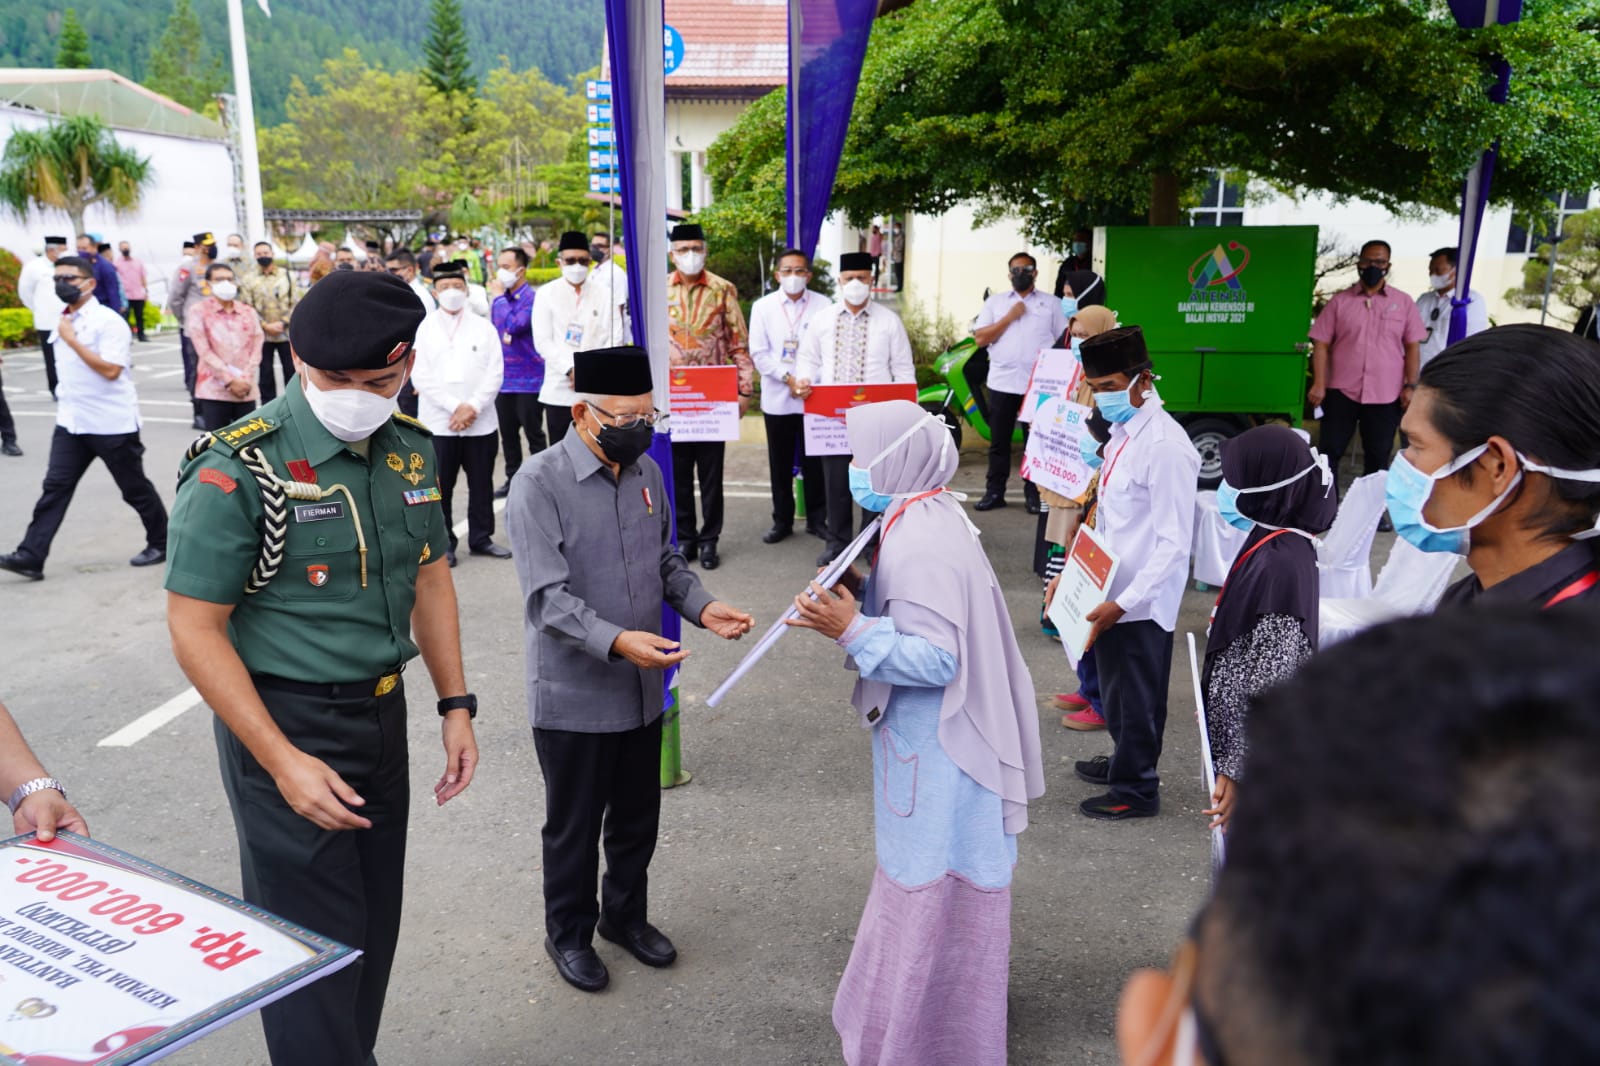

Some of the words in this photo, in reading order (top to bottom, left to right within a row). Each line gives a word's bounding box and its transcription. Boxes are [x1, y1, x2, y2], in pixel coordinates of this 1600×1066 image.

[1178, 302, 1209, 312] BANTUAN
[1210, 302, 1246, 312] KEMENSOS
[1247, 302, 1255, 312] RI
[1188, 291, 1247, 302] ATENSI
[1185, 313, 1204, 323] BALAI
[1205, 313, 1229, 323] INSYAF
[1230, 313, 1246, 323] 2021
[1066, 409, 1080, 425] BSI
[303, 506, 336, 517] FIERMAN
[15, 901, 137, 955] (BTPKLWN)
[2, 925, 75, 960] WARUNG
[190, 926, 262, 971] Rp.
[72, 953, 114, 979] PKL,
[105, 972, 180, 1009] KEPADA
